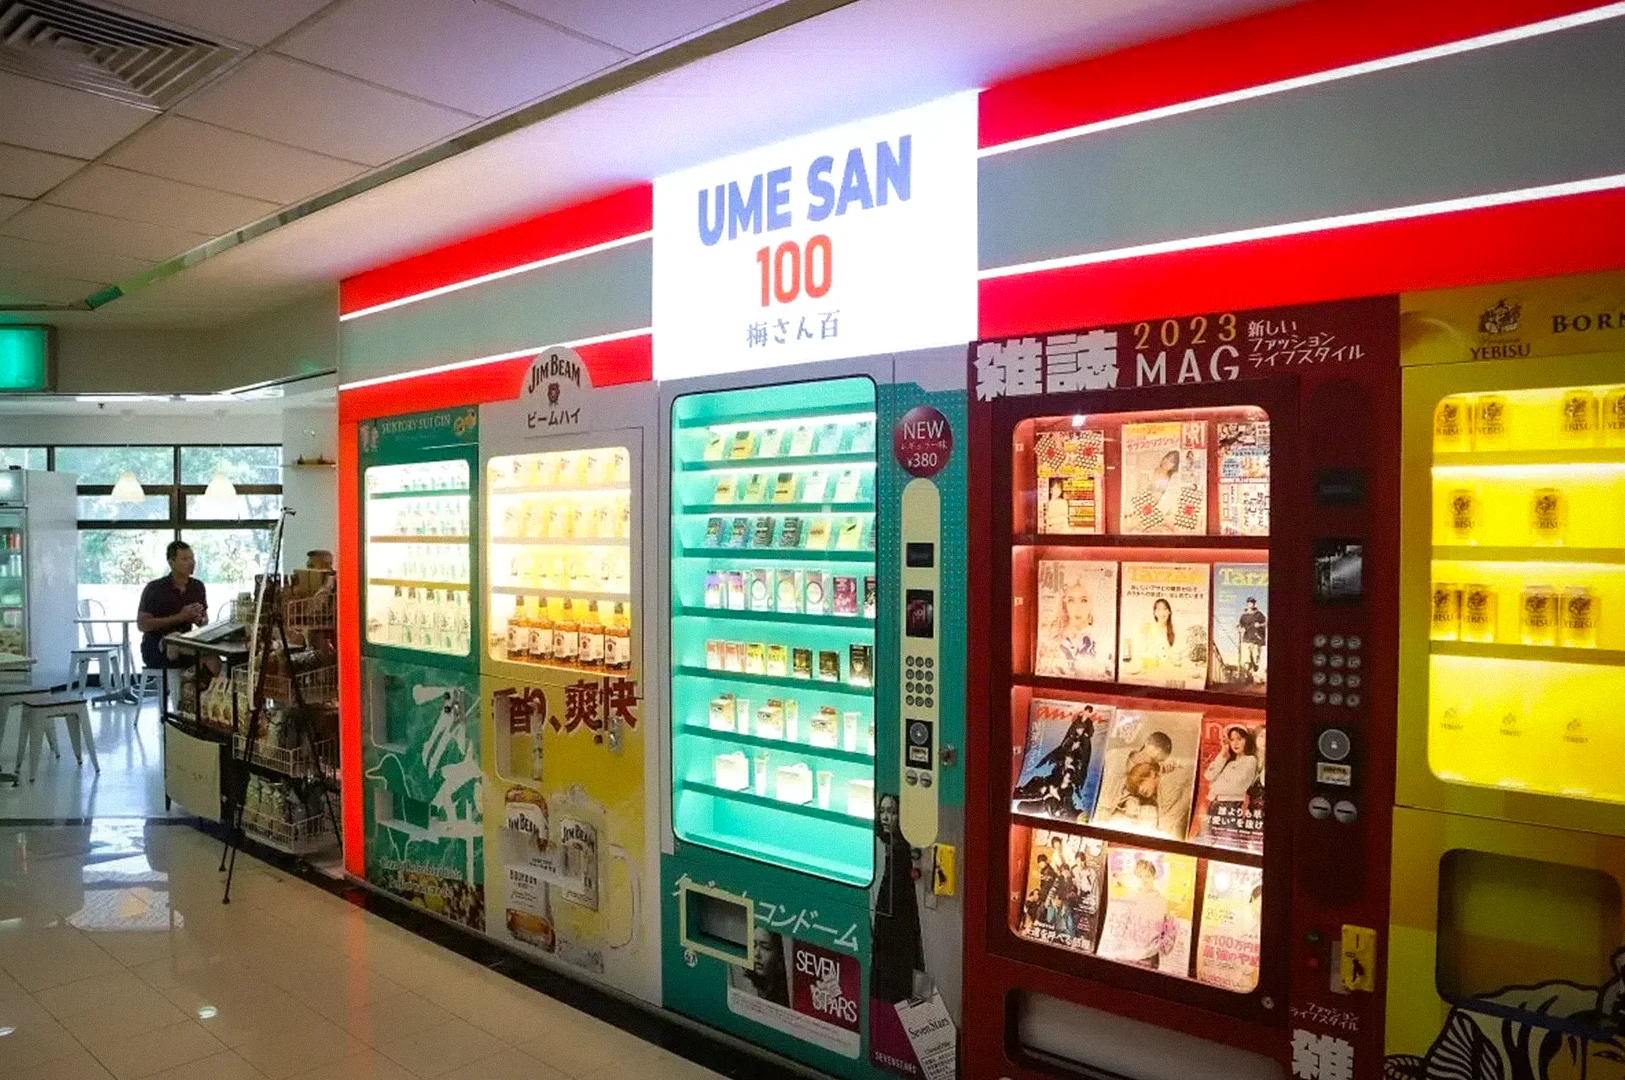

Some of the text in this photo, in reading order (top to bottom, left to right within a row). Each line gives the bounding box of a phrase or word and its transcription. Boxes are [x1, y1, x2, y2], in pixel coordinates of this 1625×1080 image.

[698, 134, 912, 247] UME SAN
[756, 234, 832, 307] 100
[746, 310, 840, 348] 梅さん百
[1134, 313, 1237, 350] 2023
[1248, 319, 1298, 339] 新しい
[1248, 331, 1337, 352] ファッション
[974, 329, 1120, 402] 雑誌
[1135, 345, 1240, 387] MAG
[1248, 344, 1366, 368] ライフスタイル
[1469, 343, 1531, 360] YEBISU
[528, 353, 581, 393] JIM BEAM
[527, 408, 581, 429] ビームハイ
[903, 420, 944, 440] NEW
[908, 452, 938, 467] ¥380
[796, 950, 840, 984] SEVEN
[812, 990, 858, 1023] STARS
